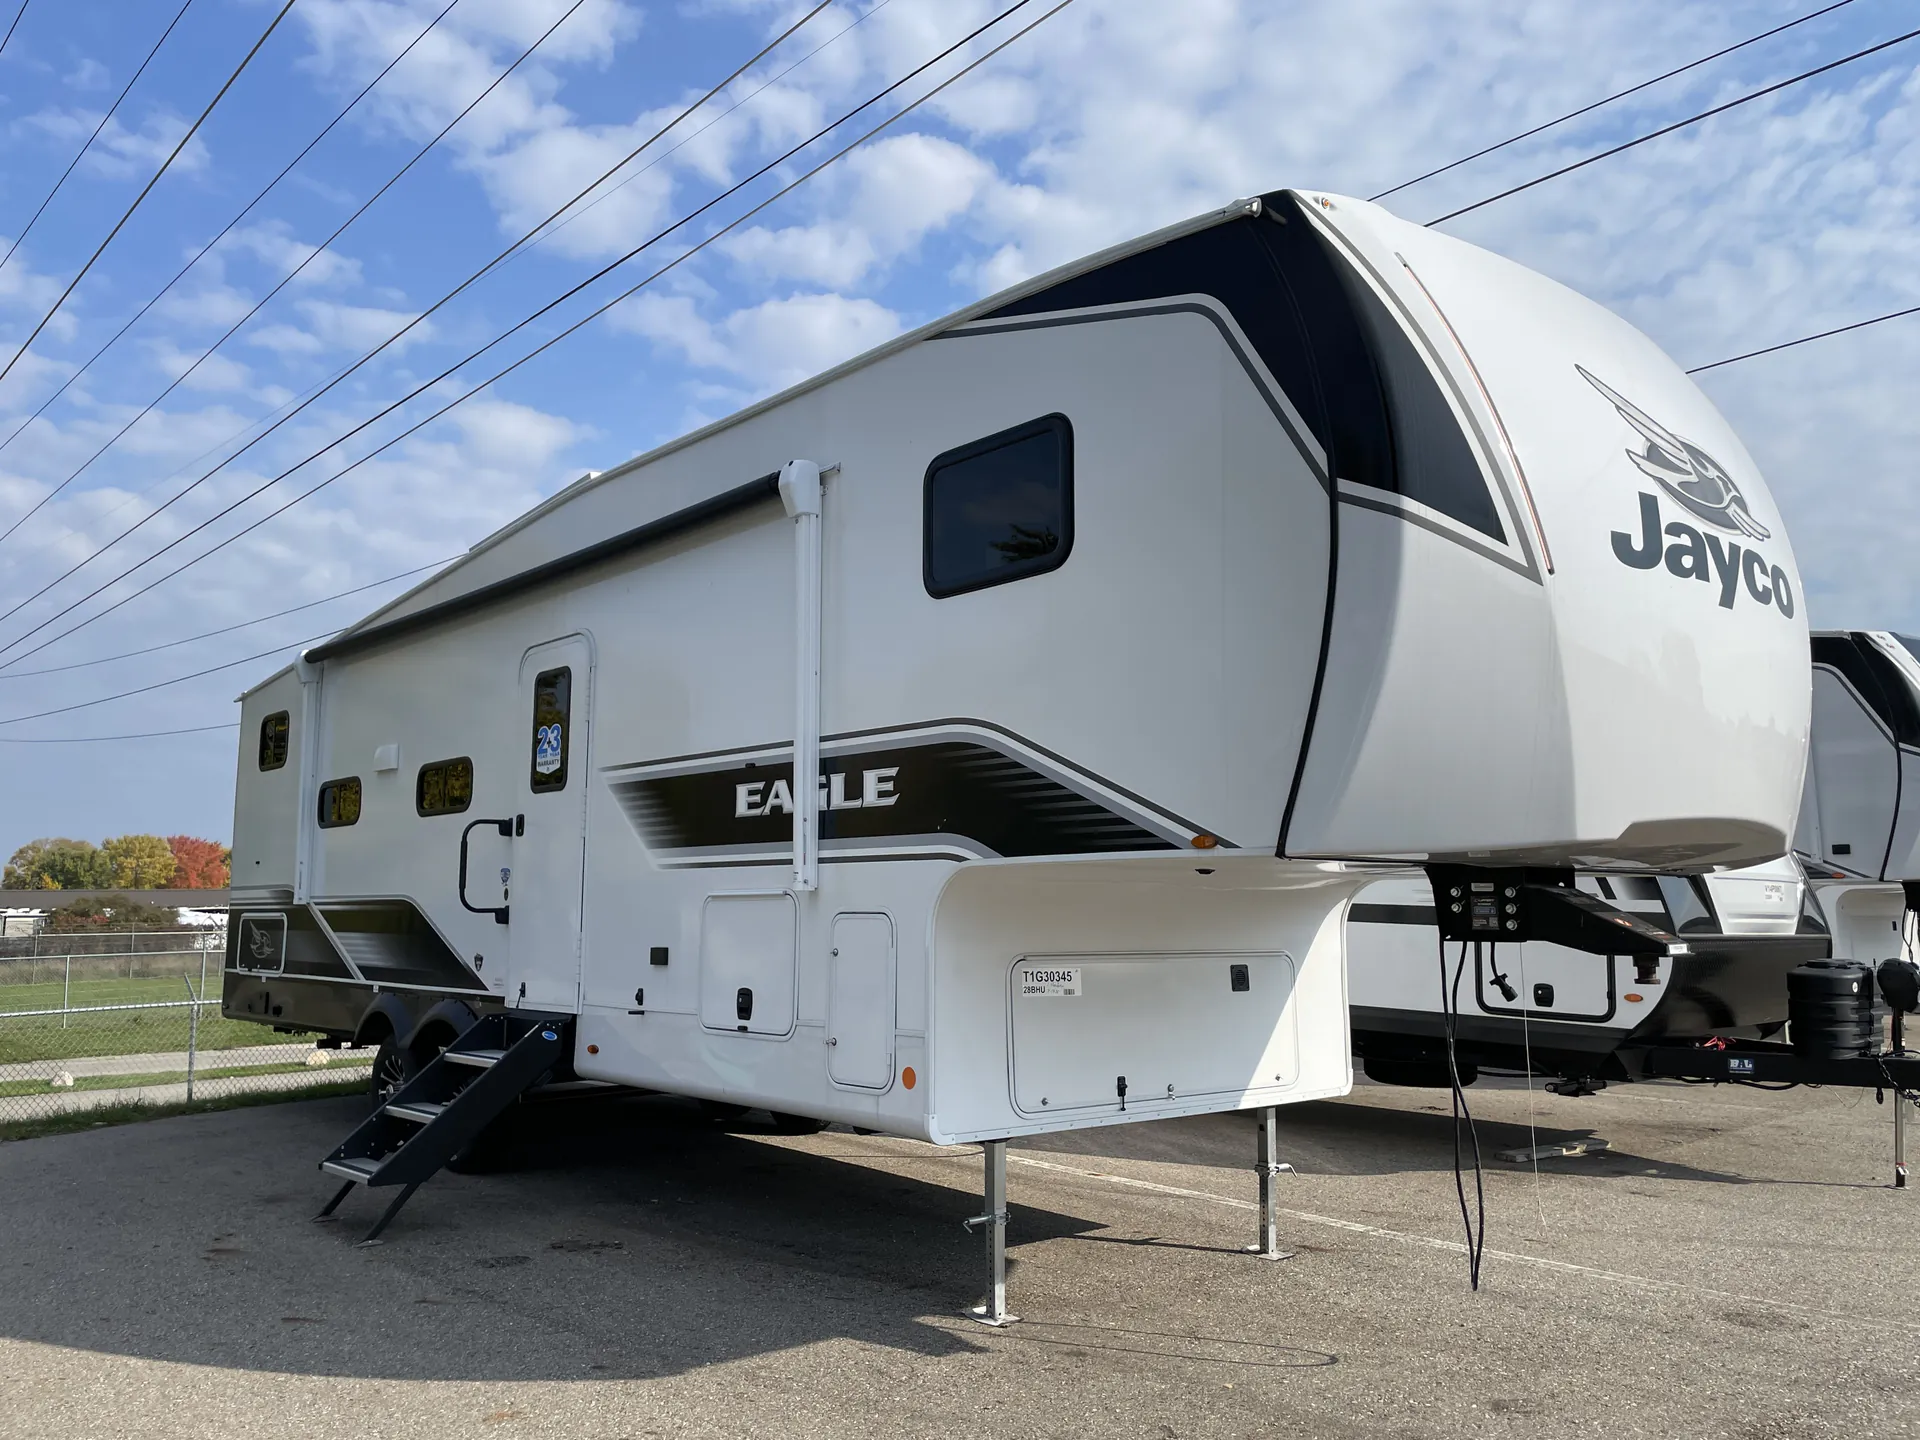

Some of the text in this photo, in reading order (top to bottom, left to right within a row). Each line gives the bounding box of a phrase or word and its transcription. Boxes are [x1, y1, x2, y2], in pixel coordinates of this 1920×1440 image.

[1611, 491, 1794, 619] Jayco
[1022, 971, 1072, 982] T1G30345
[1023, 985, 1045, 994] 28BHU
